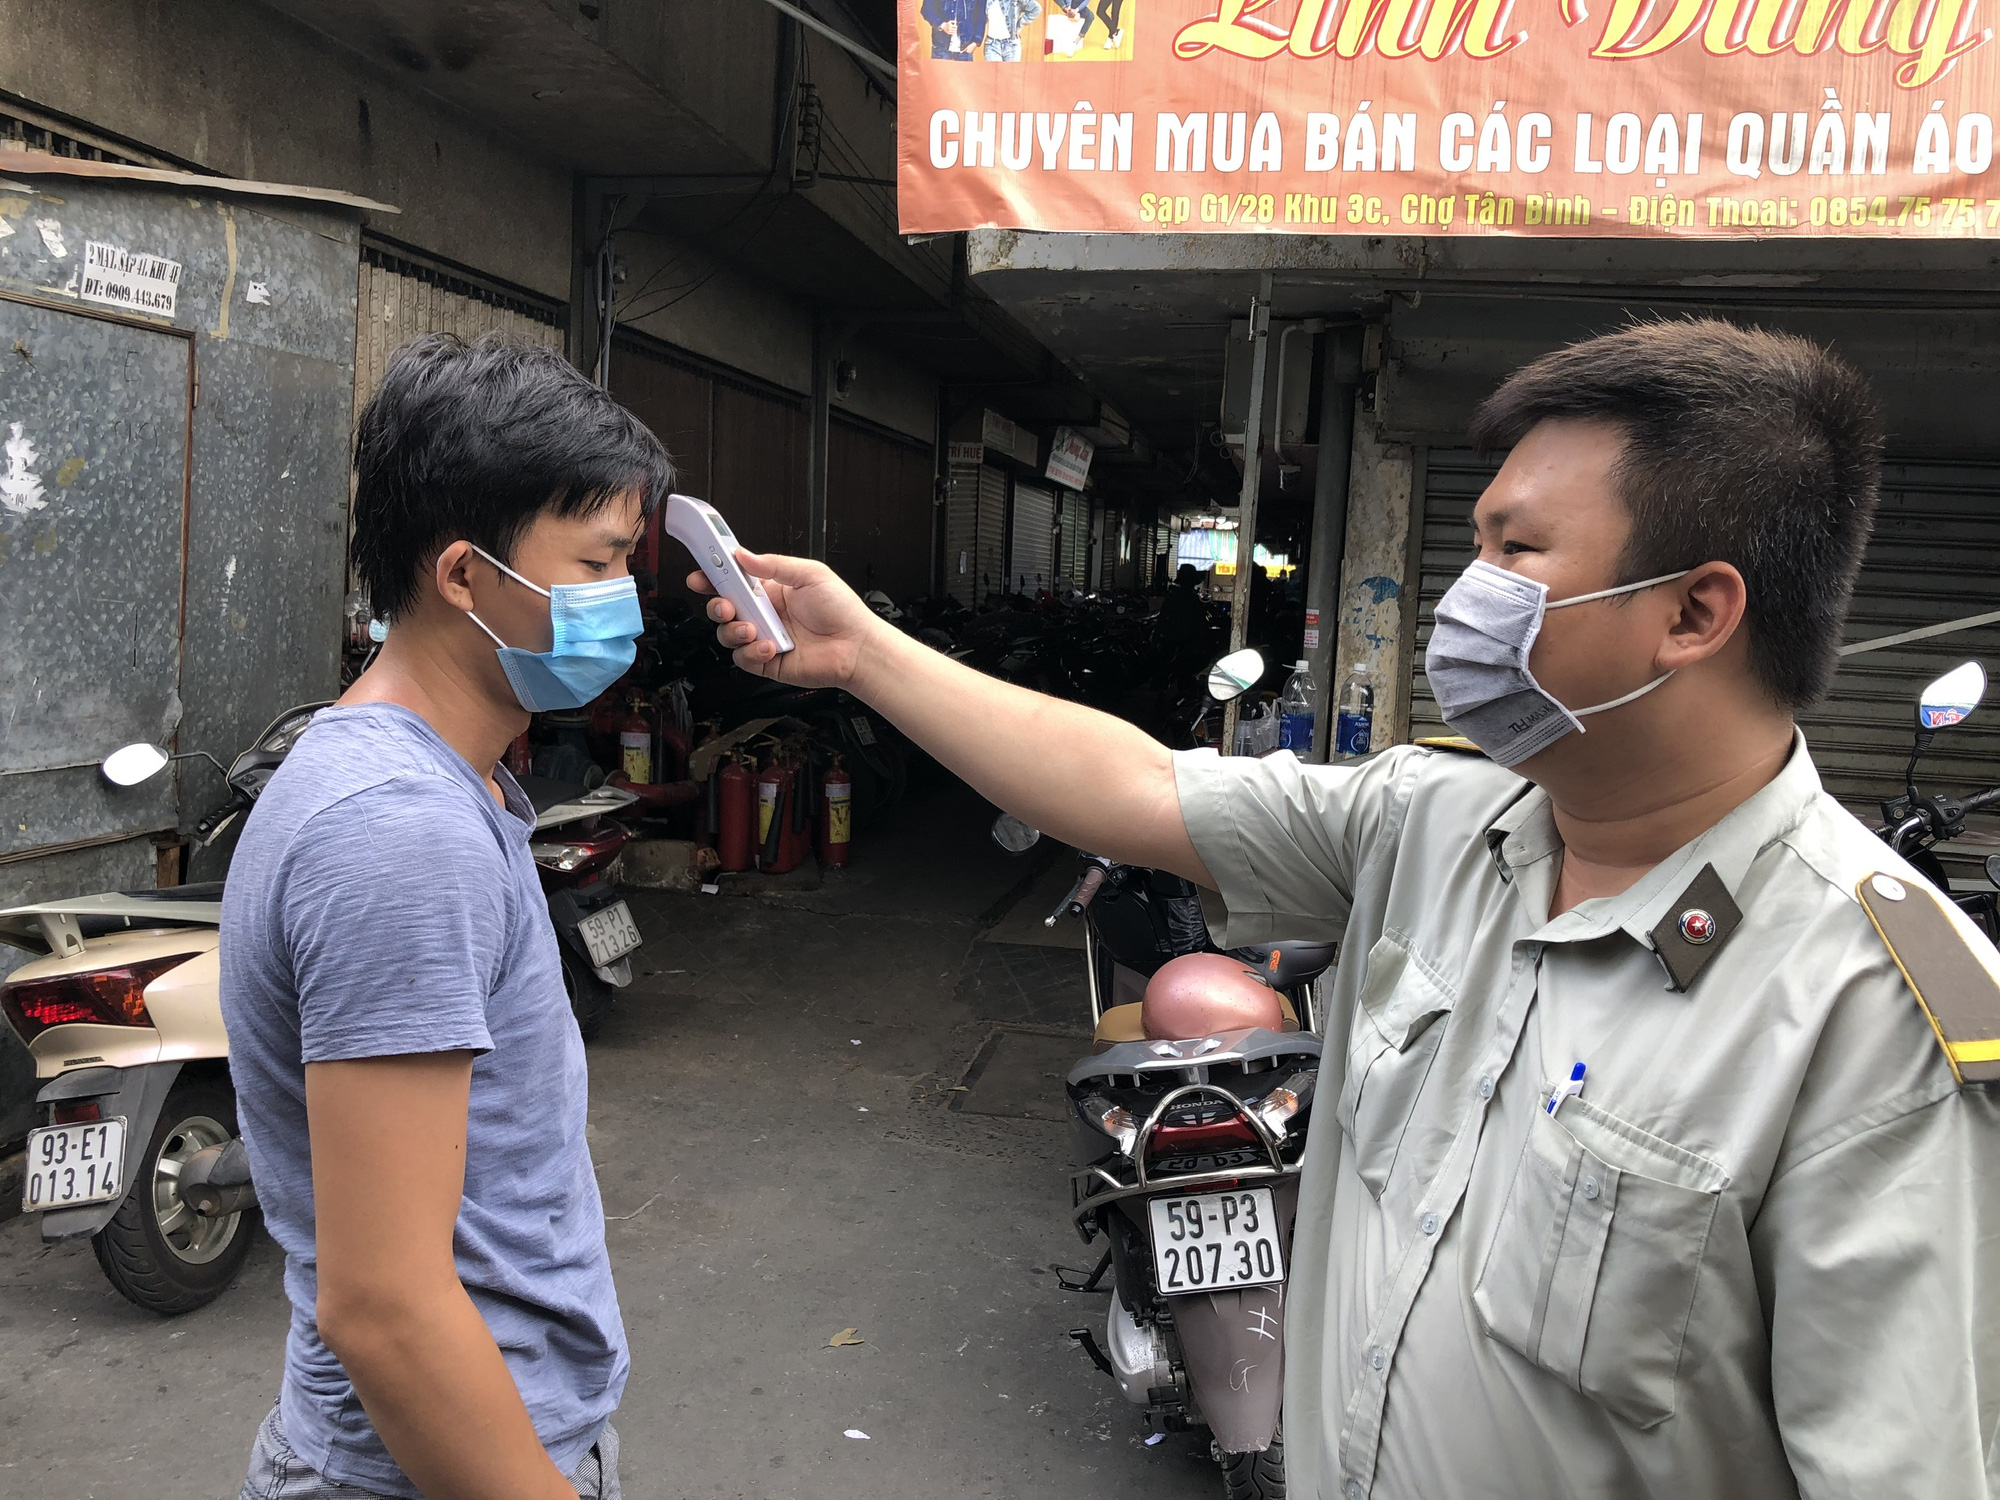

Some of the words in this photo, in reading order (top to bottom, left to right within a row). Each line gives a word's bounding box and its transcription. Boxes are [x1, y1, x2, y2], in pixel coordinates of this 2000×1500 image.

[929, 101, 1133, 172] CHUYÊN
[1154, 111, 1283, 173] MUA
[1304, 101, 1416, 173] BÁN
[1438, 101, 1552, 174] CÁC
[1573, 112, 1704, 188] LOẠI
[1725, 87, 1892, 181] QUẦN
[1912, 100, 1993, 175] ÁO
[1139, 192, 1191, 231] Sạp
[1200, 192, 1275, 226] G1/28
[1283, 193, 1337, 225] Khu
[1346, 194, 1391, 226] 3c,
[1401, 193, 1456, 231] Chợ
[1464, 191, 1514, 226] Tân
[1524, 192, 1592, 227] Bình
[1628, 193, 1695, 232] Điện
[1706, 196, 1799, 233] Thoại:
[1809, 195, 1932, 228] 0854.75
[1940, 196, 1976, 229] 75
[149, 260, 169, 281] KHU
[587, 906, 624, 939] 59-P1
[591, 925, 637, 963] 713.26
[1169, 1100, 1225, 1111] HONDA
[42, 1125, 108, 1166] 93-E1
[29, 1161, 114, 1205] 013.14
[1166, 1193, 1260, 1241] 59-P3
[1164, 1237, 1275, 1288] 207.30
